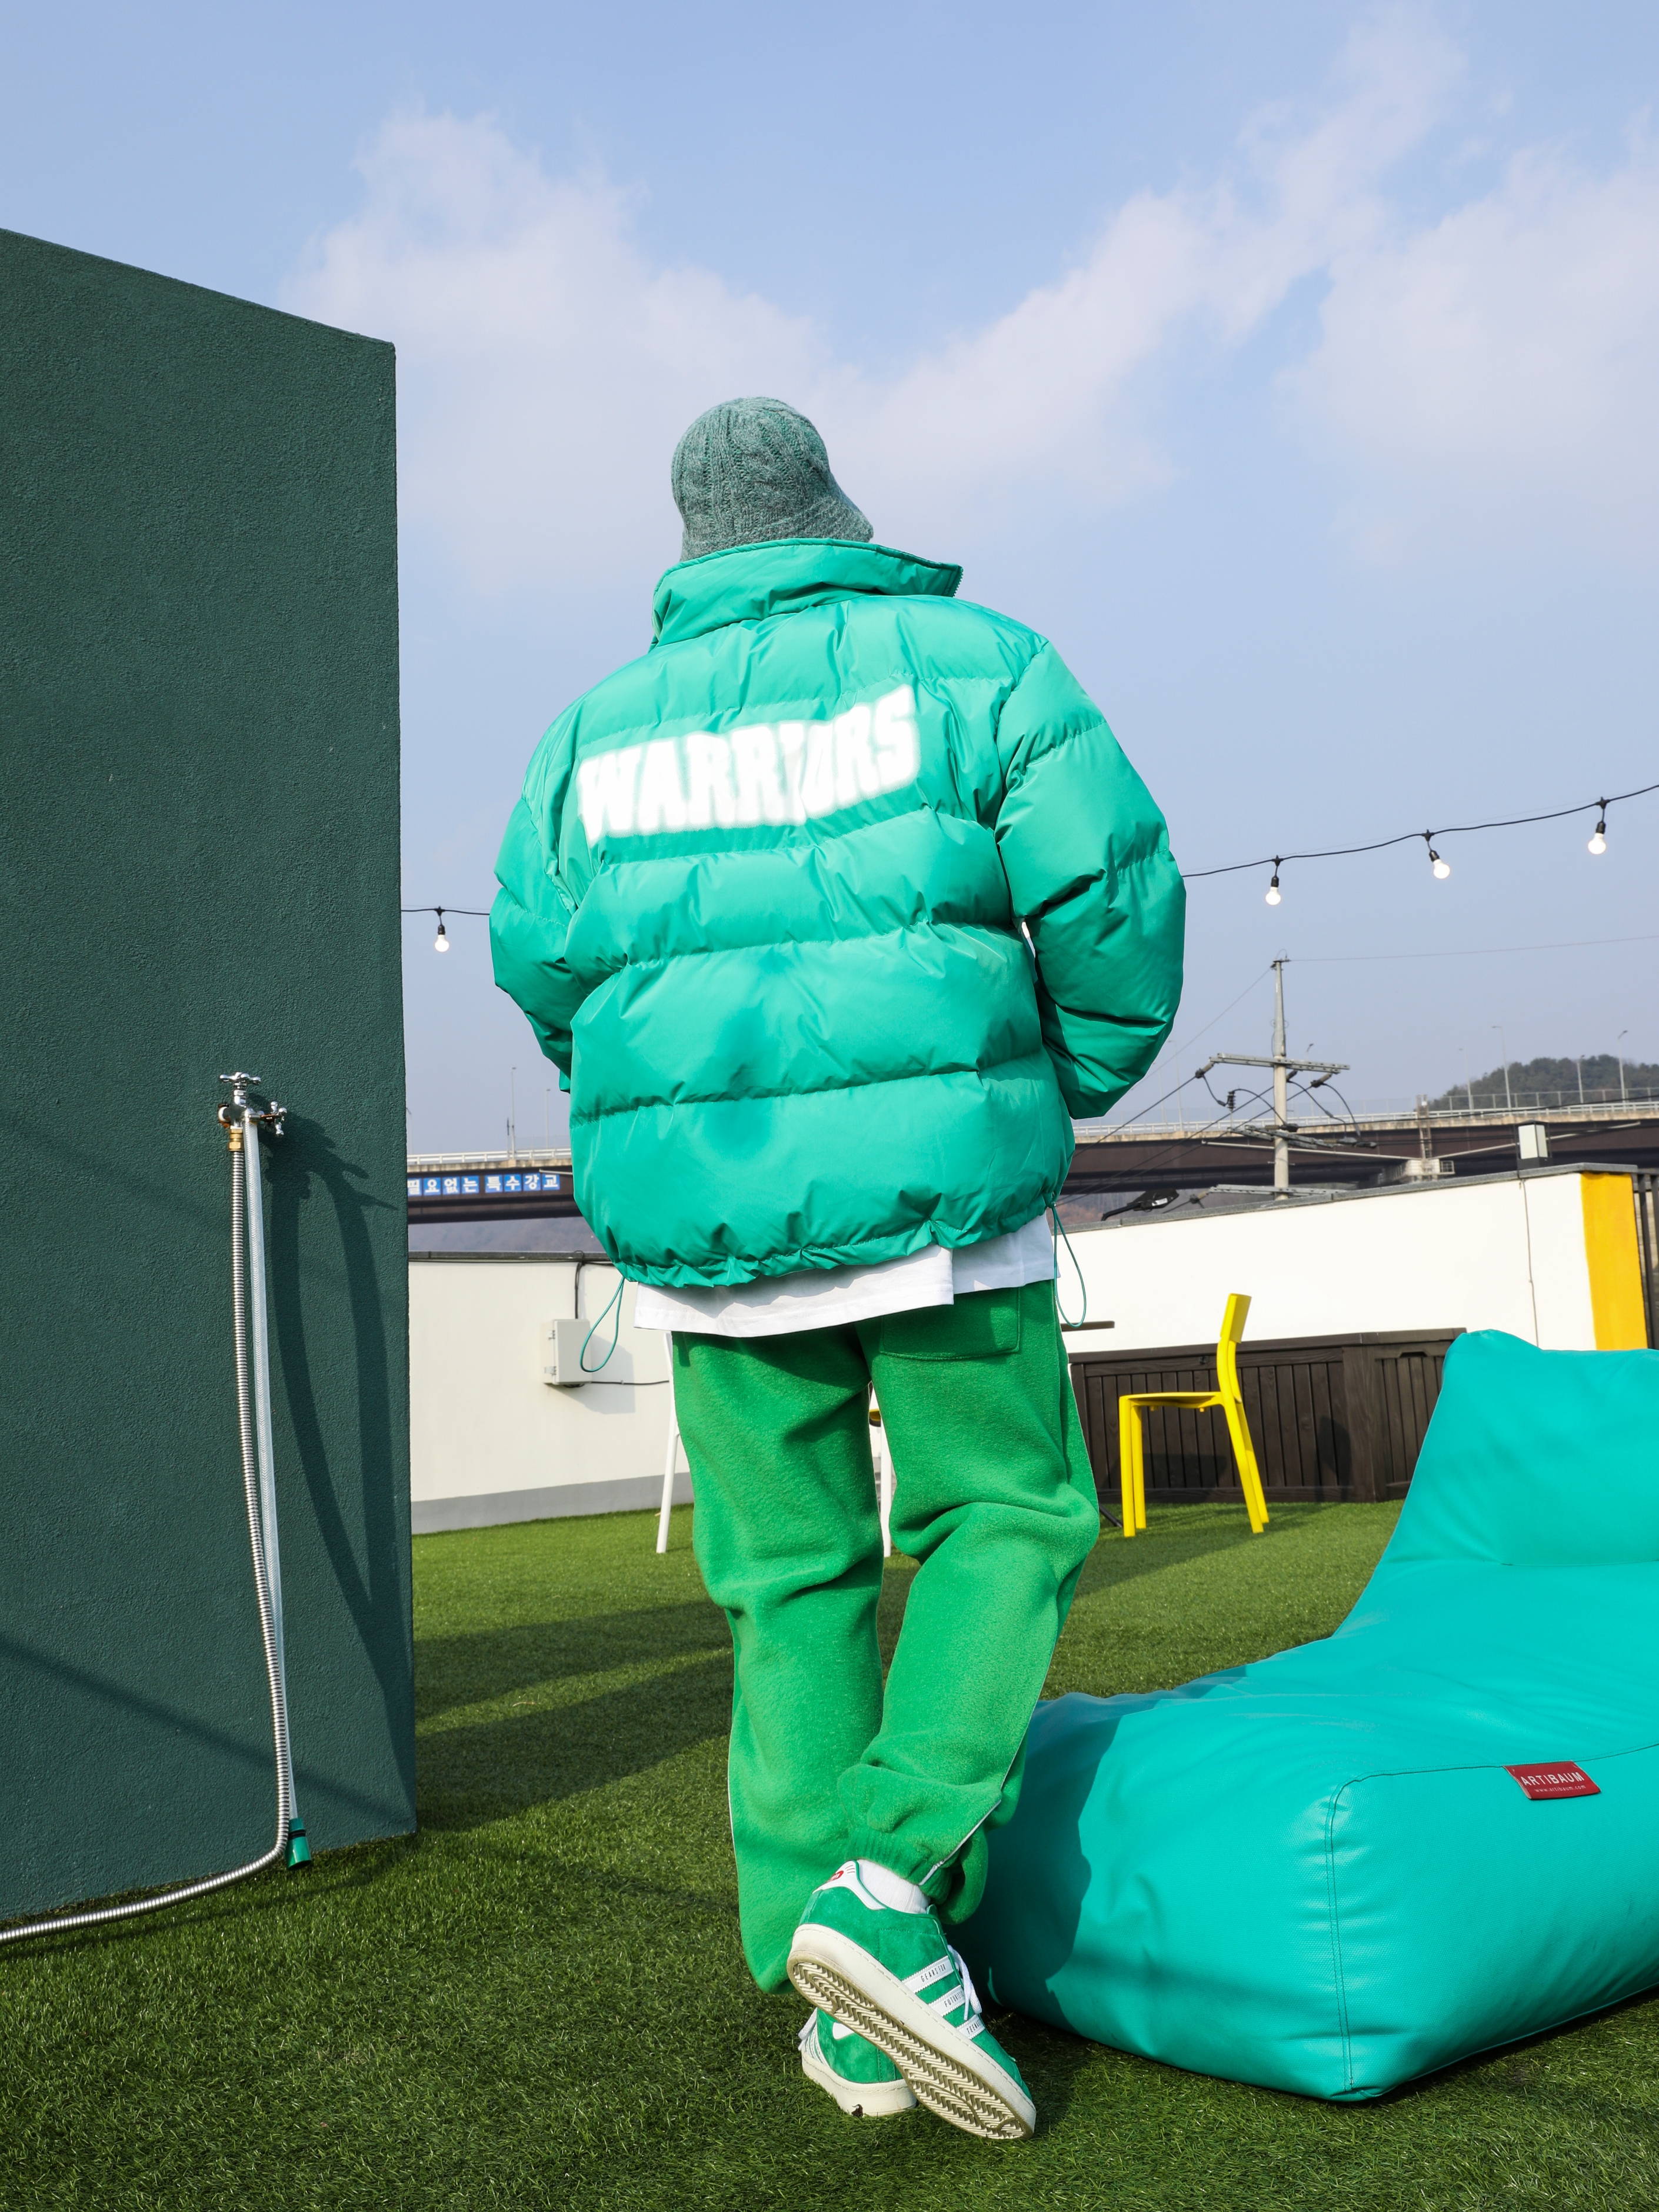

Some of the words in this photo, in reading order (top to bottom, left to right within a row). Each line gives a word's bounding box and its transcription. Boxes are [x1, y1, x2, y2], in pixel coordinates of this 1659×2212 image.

[578, 685, 920, 847] WARRIORS
[487, 1175, 558, 1191] 특수강교
[1521, 1772, 1584, 1785] ARTIBAUM
[921, 1968, 938, 1982] GEARS
